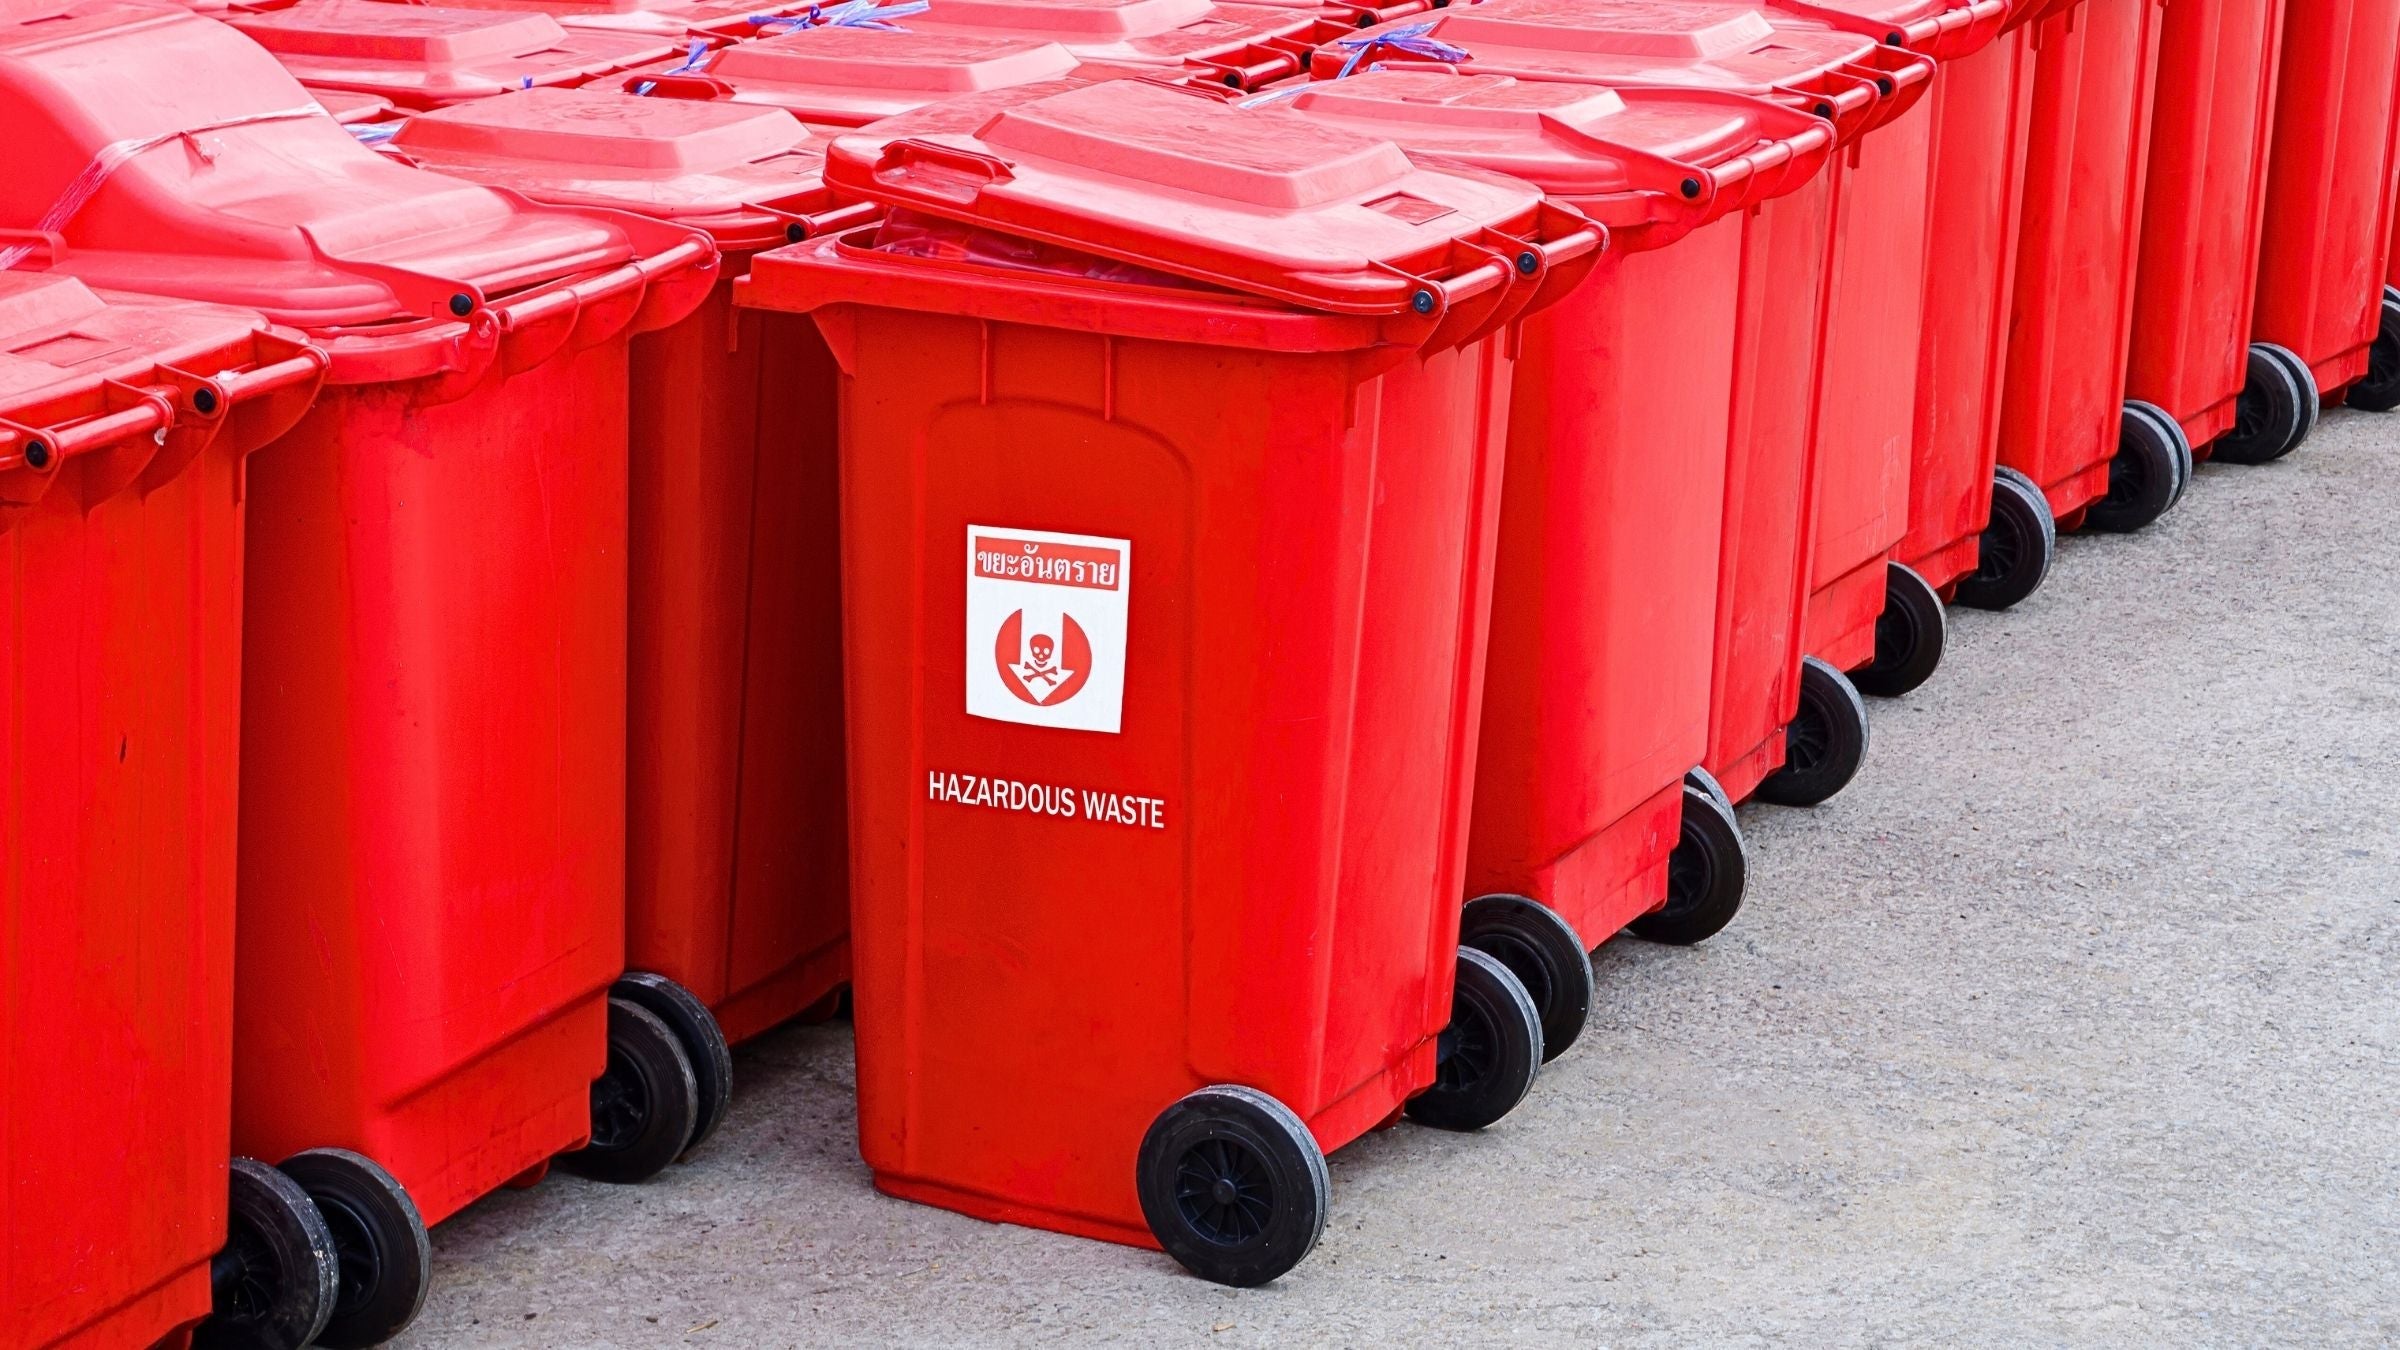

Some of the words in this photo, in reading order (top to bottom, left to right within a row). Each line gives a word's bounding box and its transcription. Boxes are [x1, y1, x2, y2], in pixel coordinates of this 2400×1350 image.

[976, 543, 1116, 585] ขยะอันตราย
[929, 771, 1075, 817] HAZARDOUS
[1082, 790, 1165, 828] WASTE
